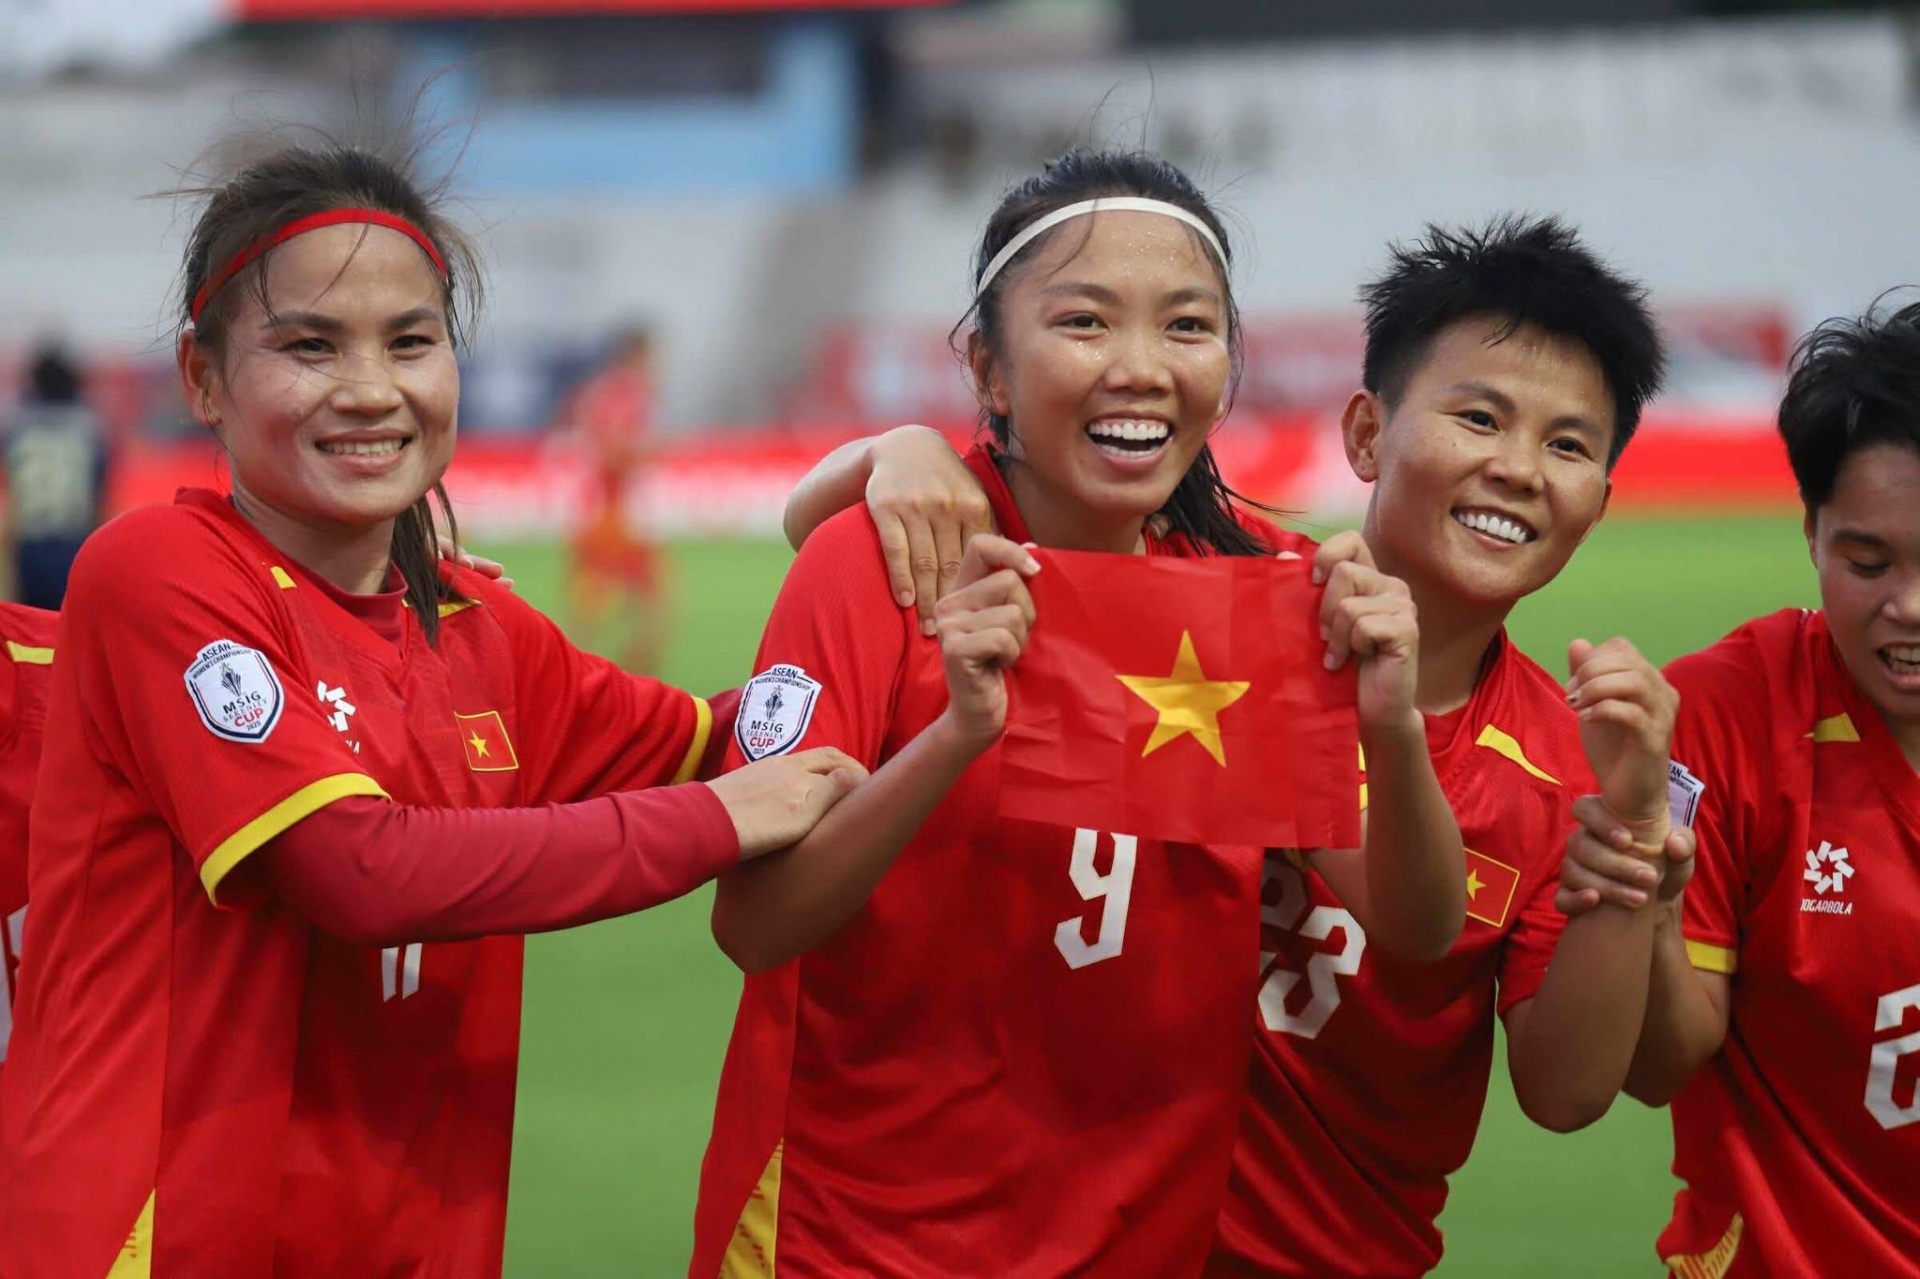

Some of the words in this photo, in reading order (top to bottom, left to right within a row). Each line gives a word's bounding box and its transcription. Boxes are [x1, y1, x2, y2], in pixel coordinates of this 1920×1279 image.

[202, 642, 231, 661] ASEAN
[771, 667, 798, 679] ASEAN
[223, 691, 261, 714] MSIG
[234, 708, 264, 727] CUP
[751, 720, 784, 733] MSIG
[750, 737, 775, 748] CUP
[1054, 827, 1138, 970] 9
